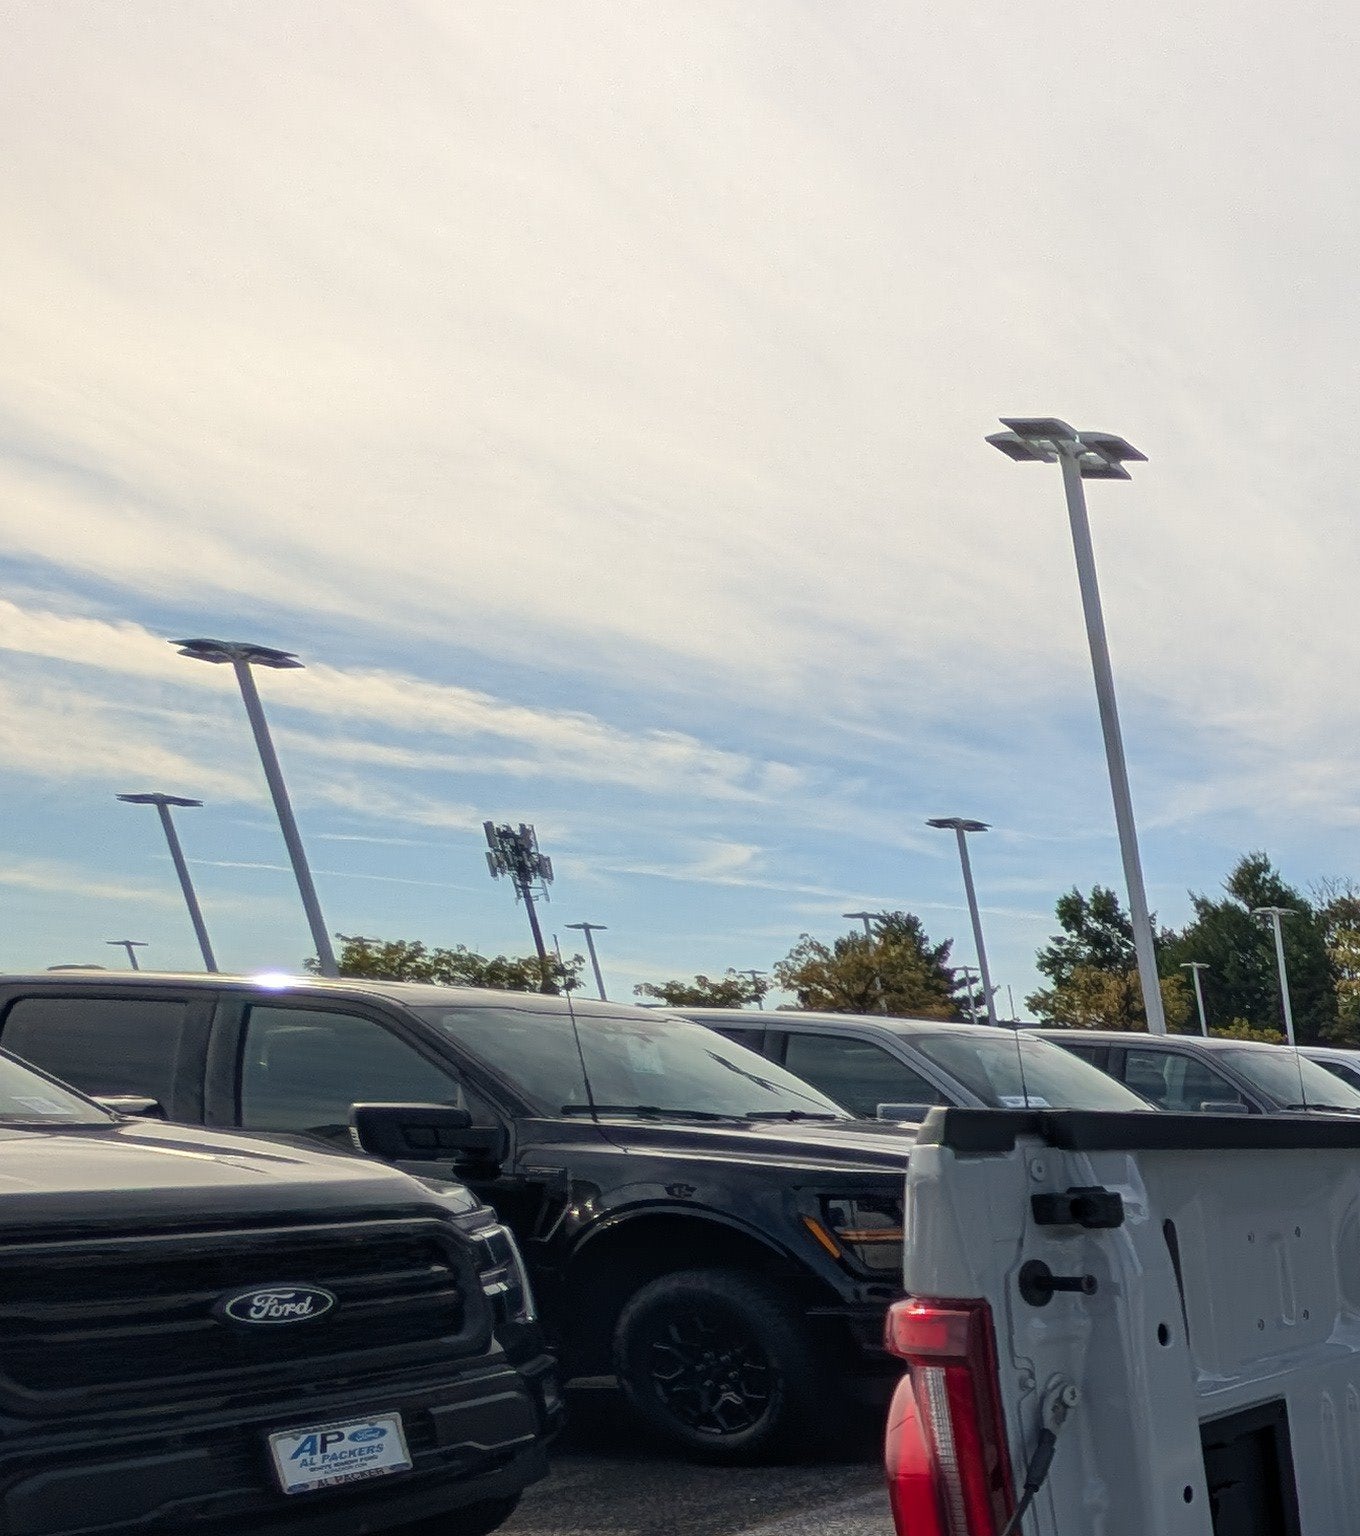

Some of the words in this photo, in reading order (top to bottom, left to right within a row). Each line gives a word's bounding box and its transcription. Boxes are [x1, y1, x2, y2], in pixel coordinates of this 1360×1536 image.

[250, 1292, 314, 1319] Ford
[290, 1430, 345, 1460] AP
[300, 1457, 317, 1469] AL
[321, 1443, 385, 1464] PACKERS
